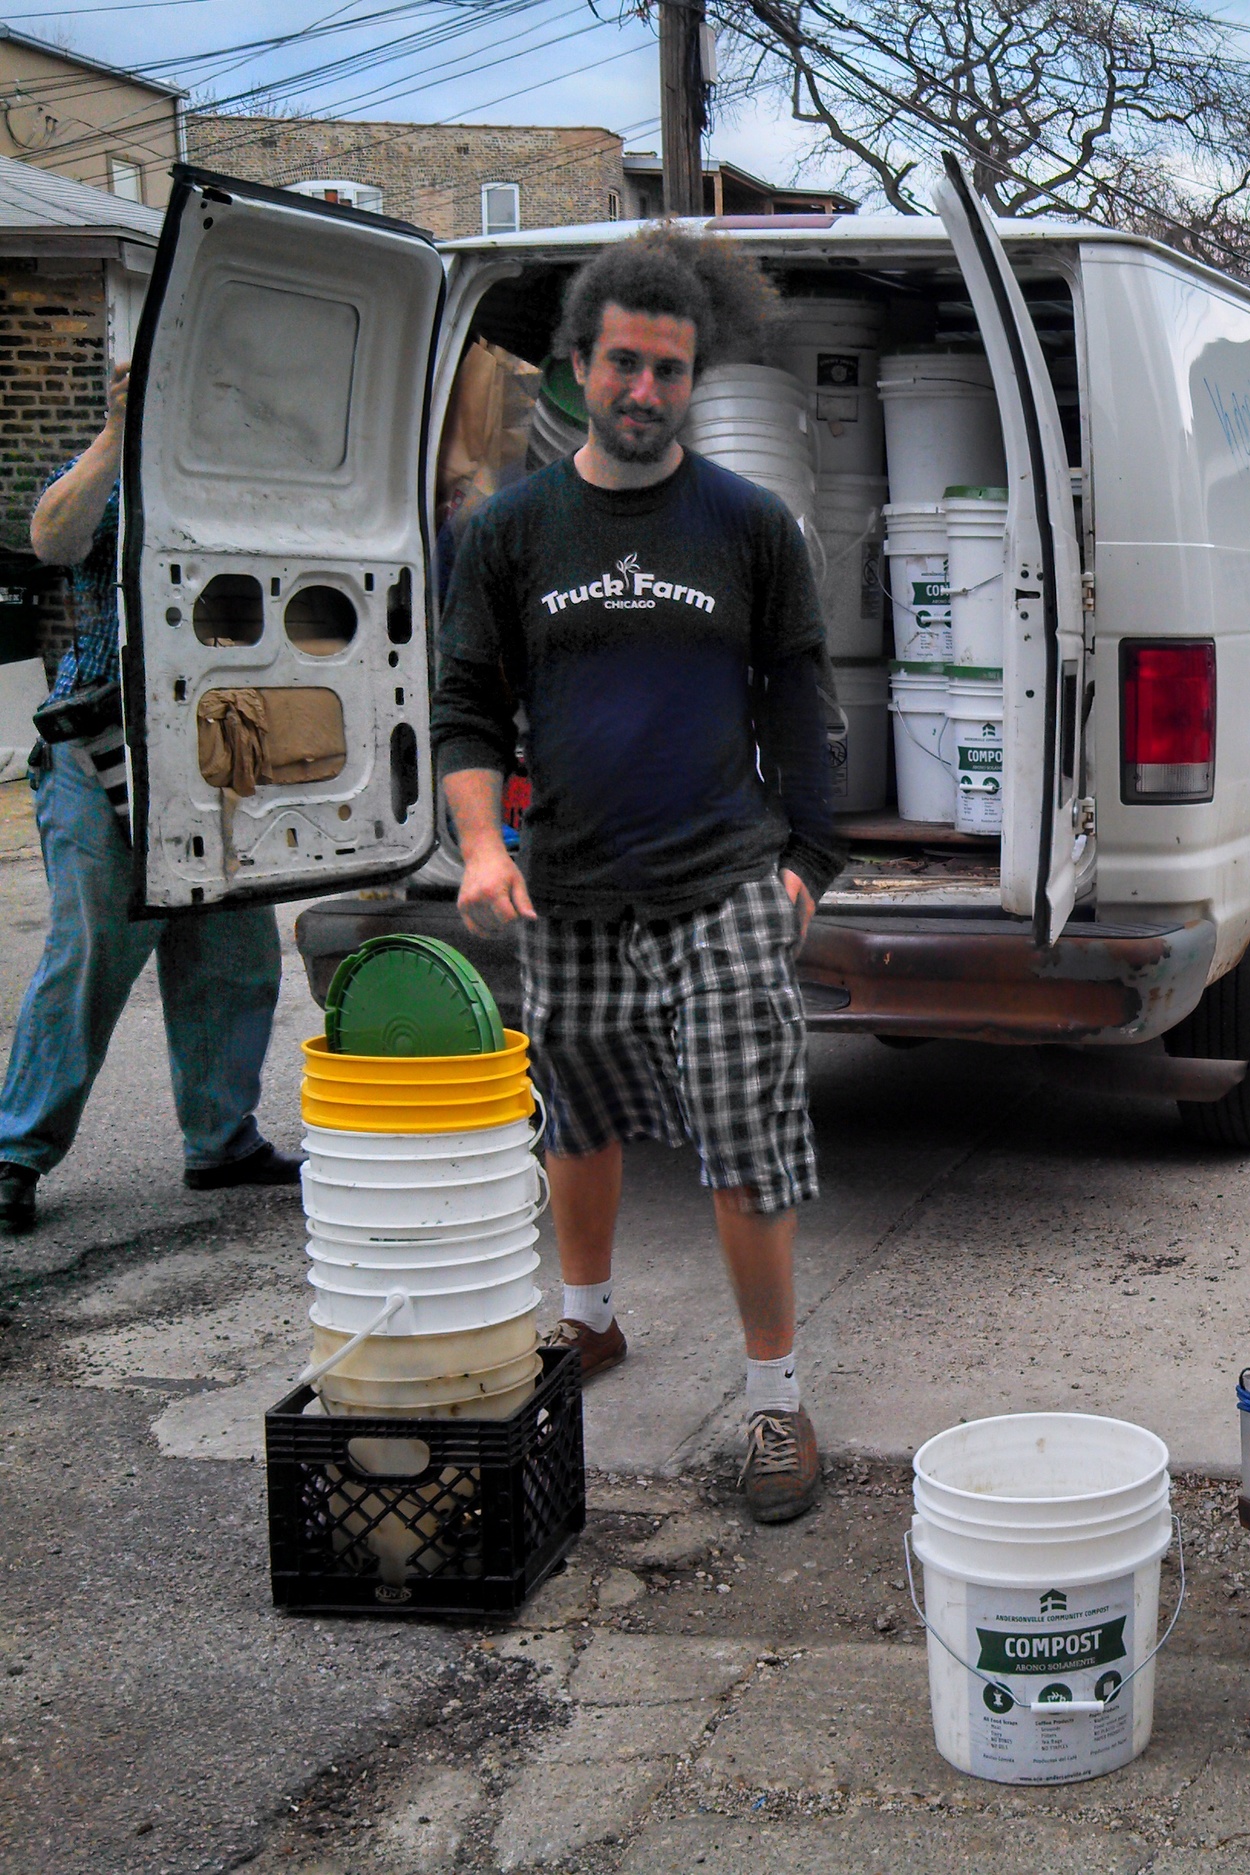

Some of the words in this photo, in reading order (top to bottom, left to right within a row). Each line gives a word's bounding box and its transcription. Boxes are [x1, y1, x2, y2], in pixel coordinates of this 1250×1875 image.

[541, 573, 624, 615] Truck
[633, 573, 716, 614] Farm
[604, 599, 656, 609] CHICAGO
[967, 749, 1003, 763] COMPO
[996, 1614, 1045, 1623] ANDERSONVILLE
[1047, 1612, 1083, 1622] COMMUNITY
[1084, 1605, 1110, 1617] COMPOST
[1004, 1629, 1103, 1658] COMPOST
[1015, 1664, 1046, 1672] ABONO
[1047, 1656, 1096, 1671] SOLAMENTE
